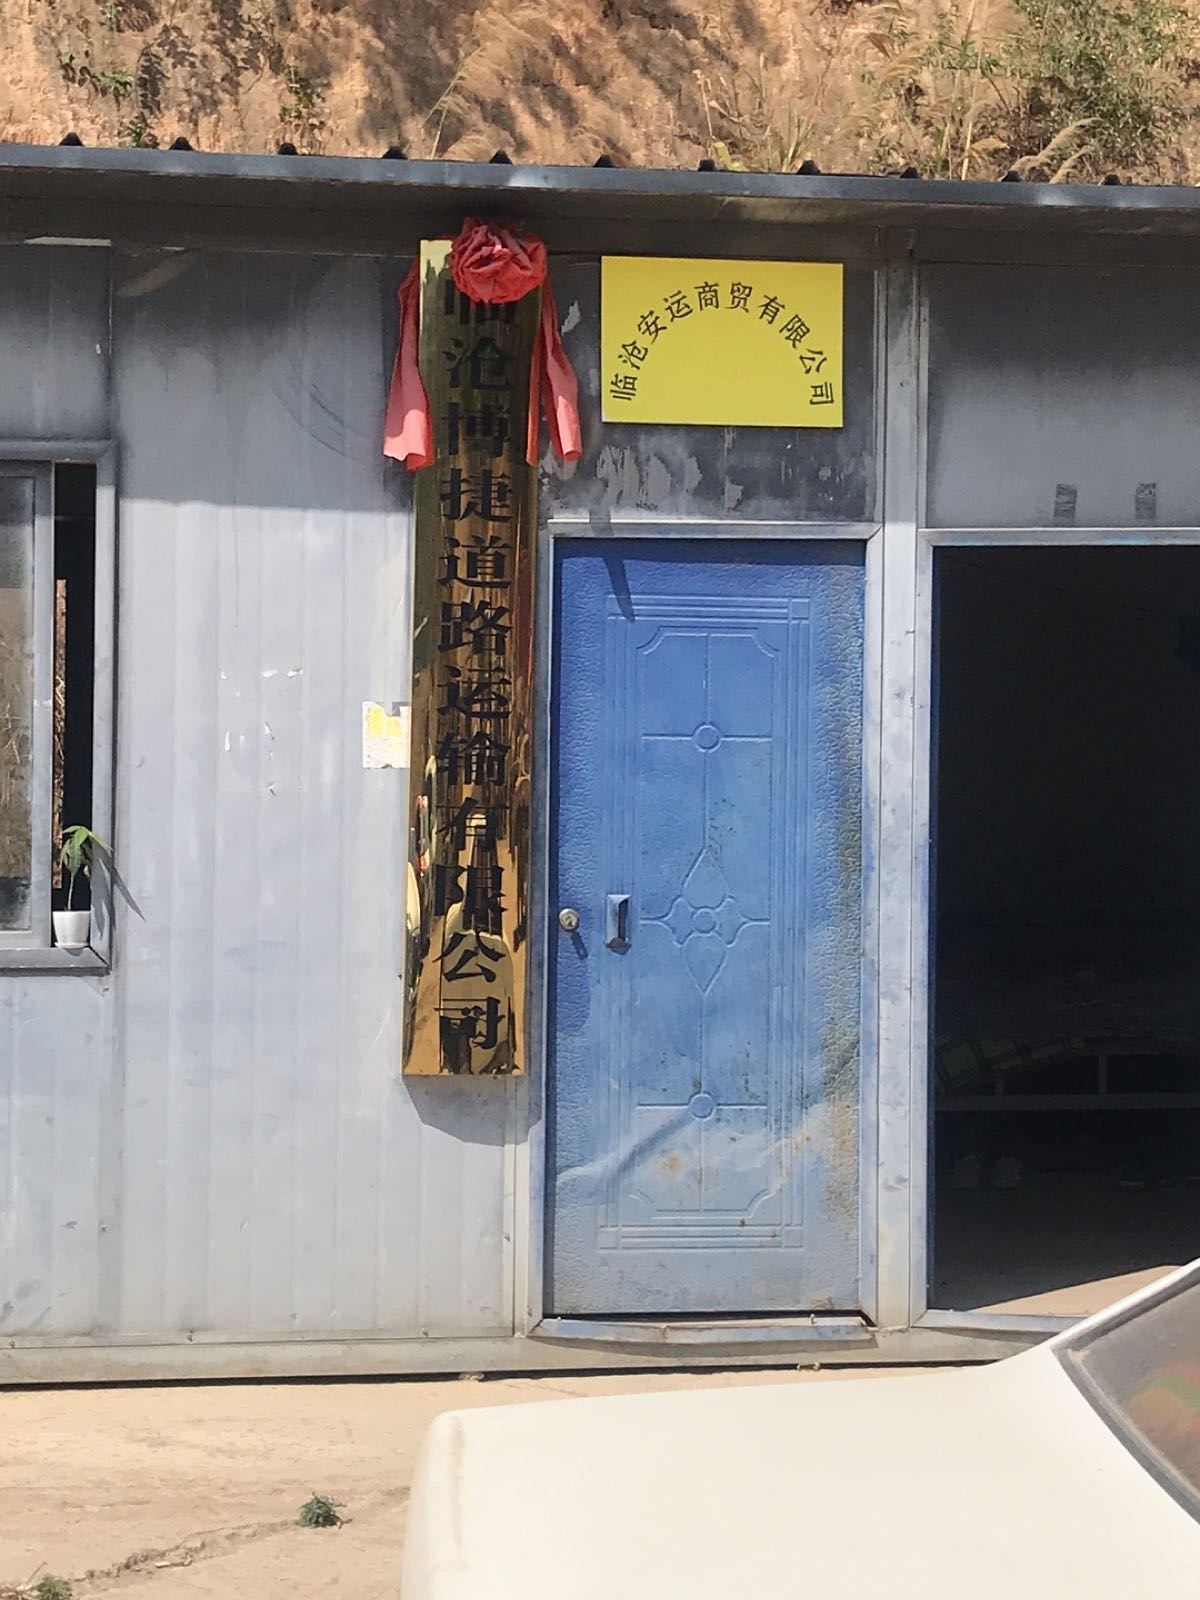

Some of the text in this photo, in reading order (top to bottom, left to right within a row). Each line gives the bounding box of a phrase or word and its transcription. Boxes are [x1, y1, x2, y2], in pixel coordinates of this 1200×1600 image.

[610, 281, 834, 405] 临沧安运商贸有限公司
